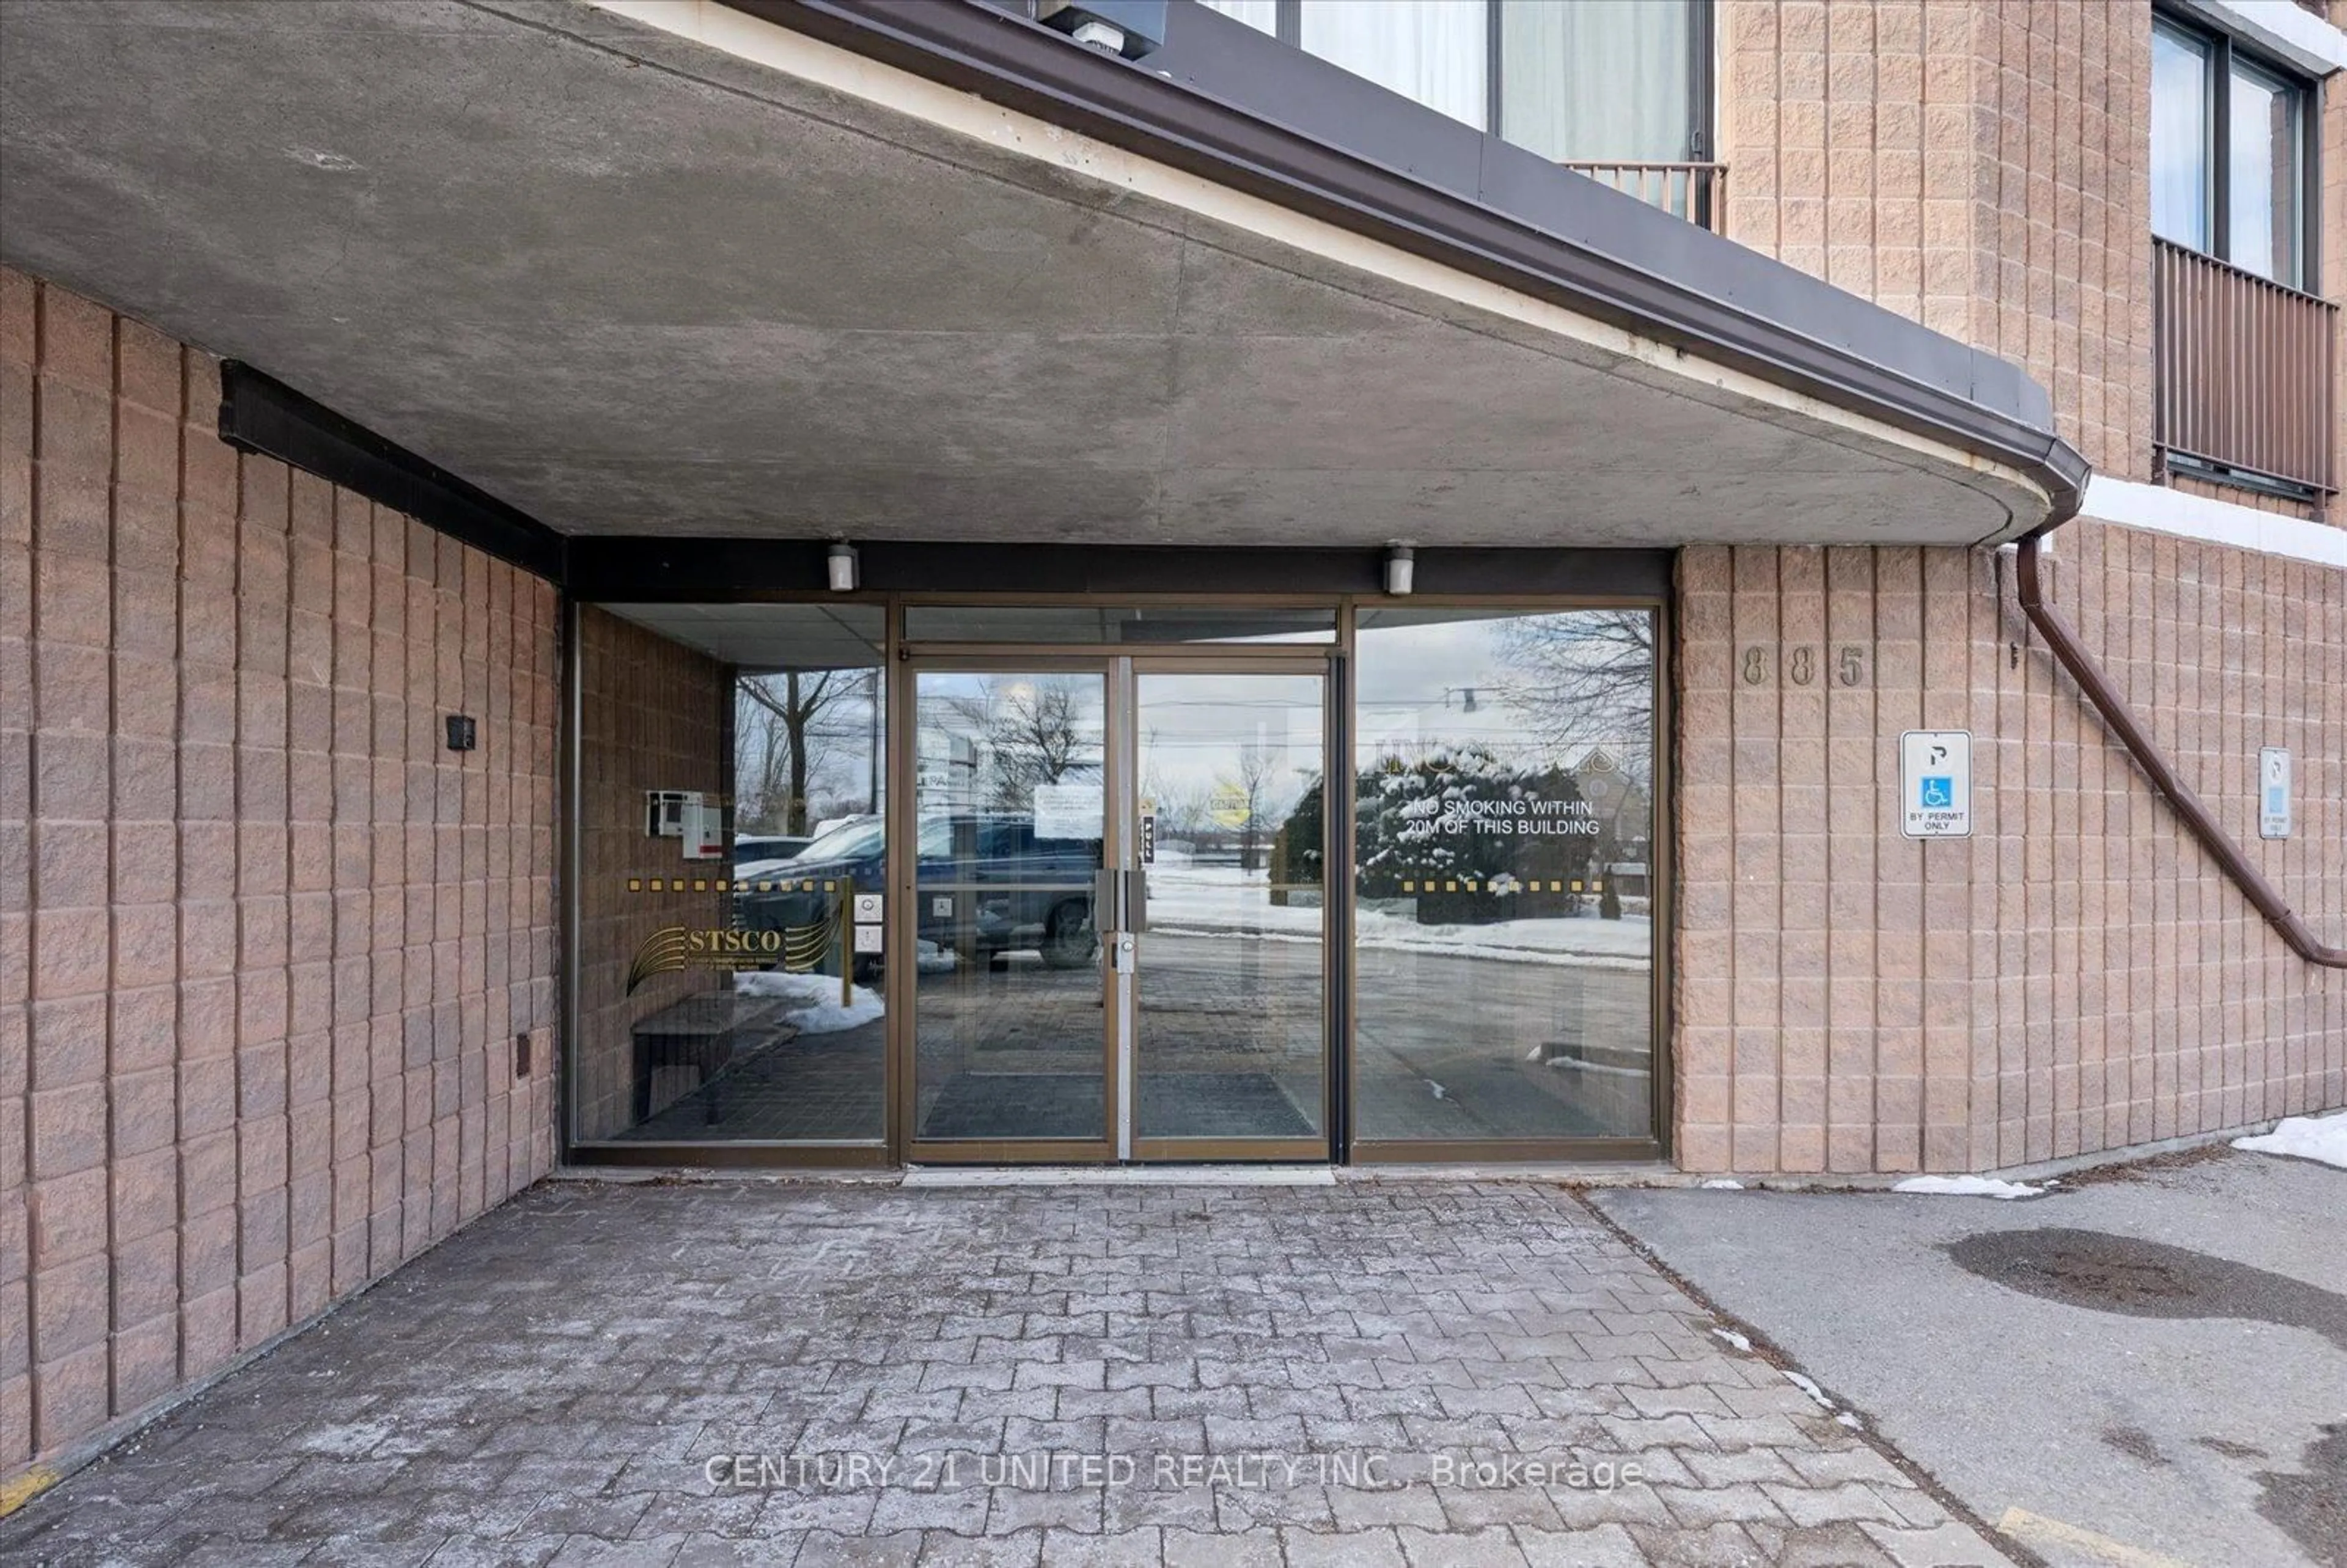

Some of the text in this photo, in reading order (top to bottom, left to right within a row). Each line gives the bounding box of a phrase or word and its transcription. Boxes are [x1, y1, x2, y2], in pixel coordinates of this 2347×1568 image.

[1744, 646, 1864, 687] 885
[1412, 800, 1593, 815] NO SMOKING WITHIN
[1928, 812, 1964, 821] PERMIT
[1406, 820, 1600, 835] 20M OF THIS BUILDING
[1925, 822, 1950, 830] ONLY
[689, 930, 781, 951] STSCO
